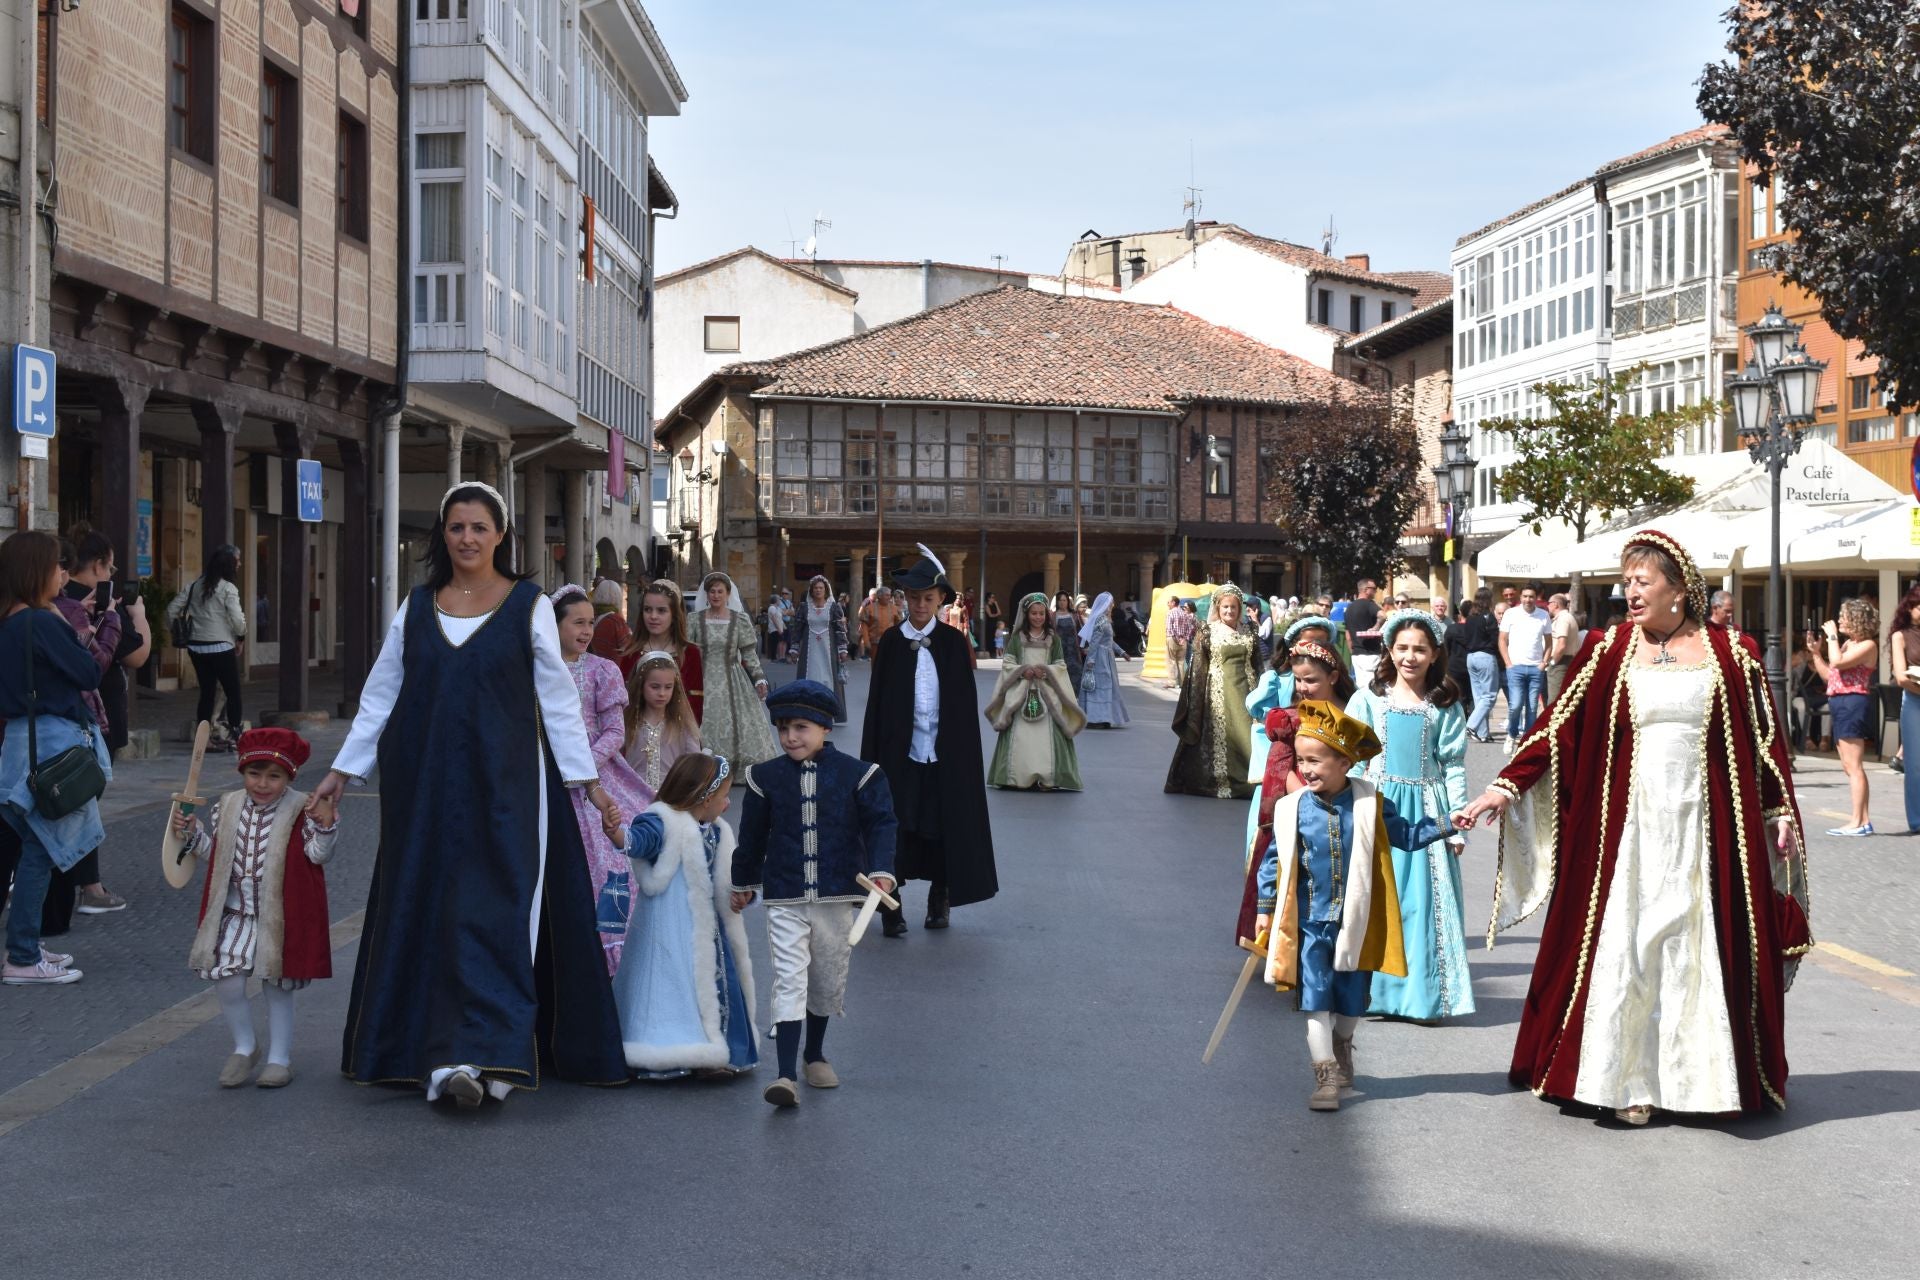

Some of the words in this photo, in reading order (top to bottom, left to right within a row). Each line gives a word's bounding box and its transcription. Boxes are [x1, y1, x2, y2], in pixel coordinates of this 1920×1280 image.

[25, 356, 48, 424] P
[1803, 465, 1833, 479] Café
[302, 481, 321, 500] TAXI
[1786, 487, 1850, 501] Pastelería
